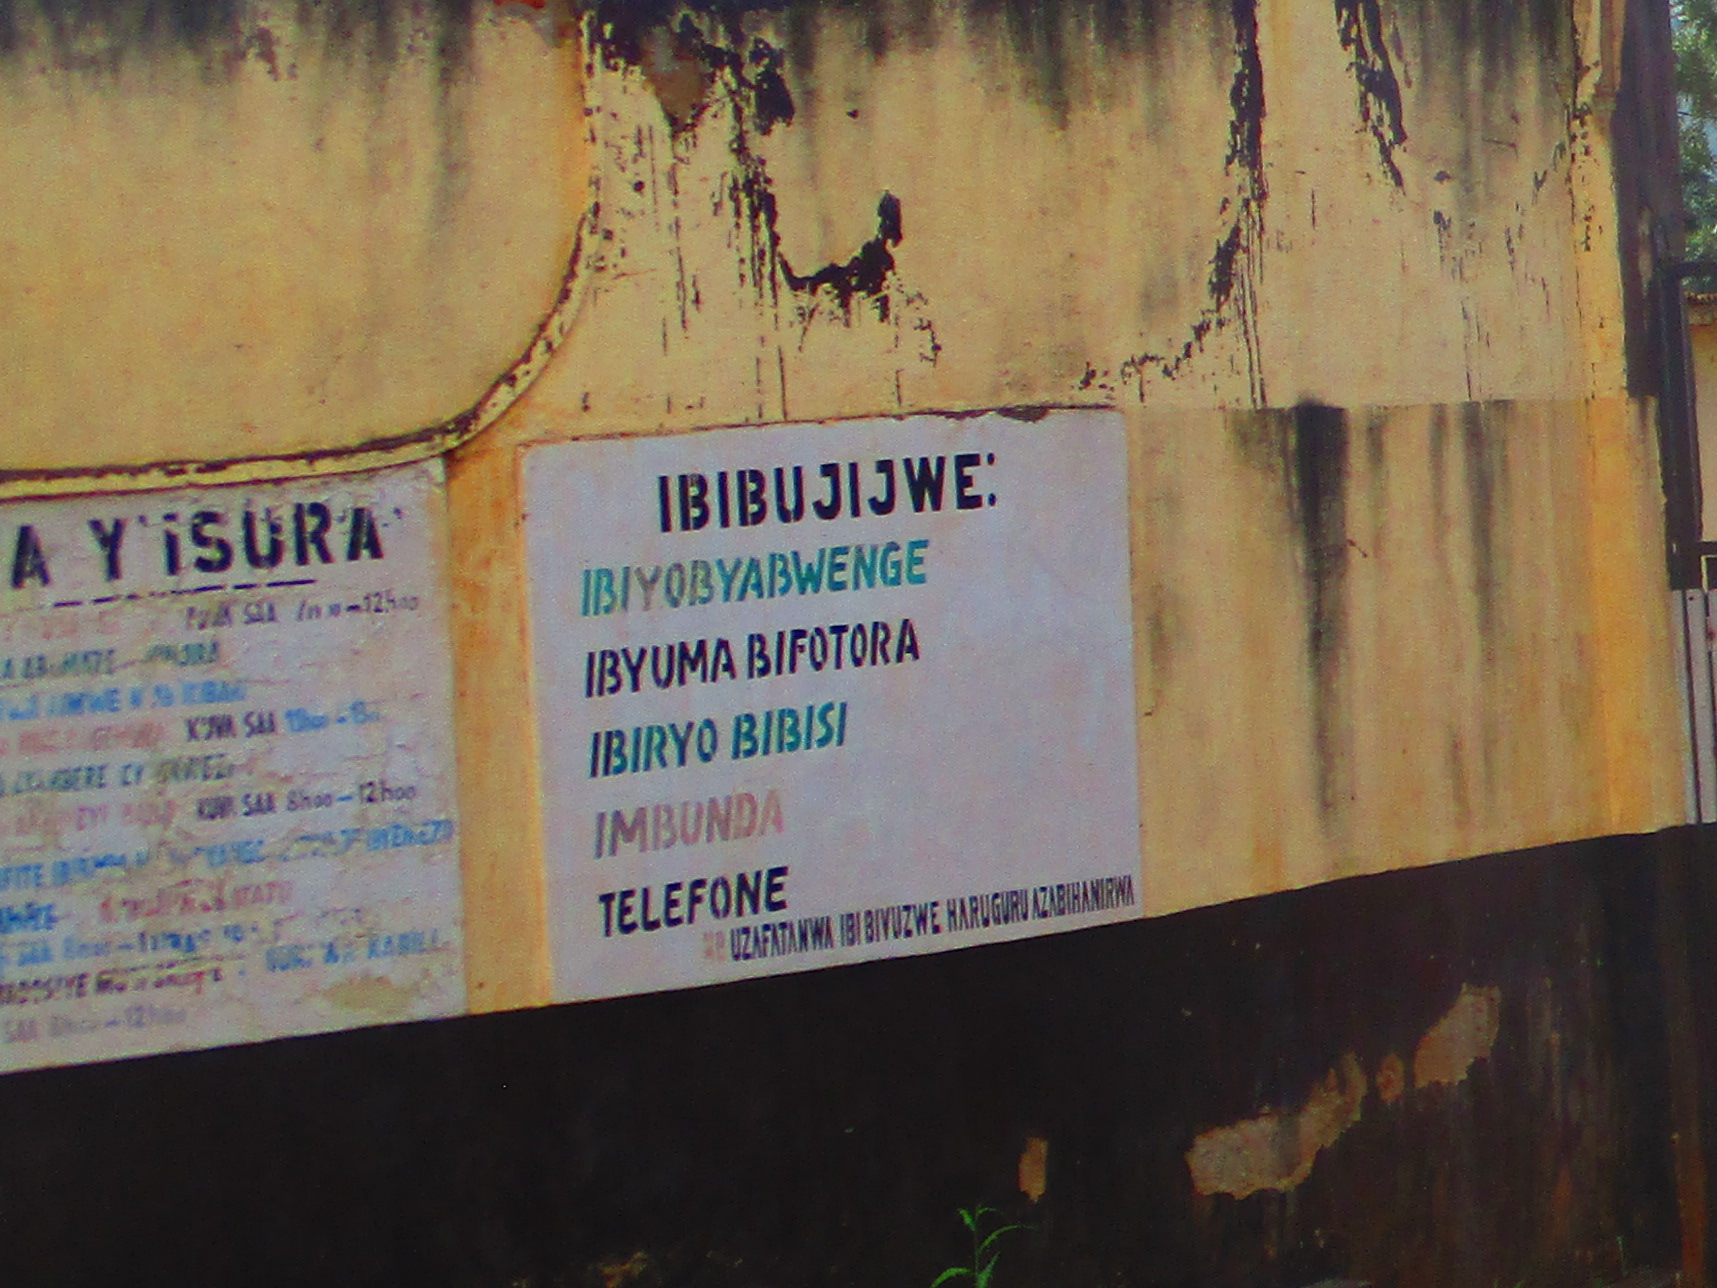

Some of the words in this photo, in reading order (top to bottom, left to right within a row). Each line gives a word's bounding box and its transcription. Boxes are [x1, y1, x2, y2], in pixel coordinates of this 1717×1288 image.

[657, 452, 998, 533] IBIBUJIJWE:
[581, 539, 930, 616] IBIYOBYABWENGE
[584, 636, 737, 698] IBYUMA
[746, 617, 920, 679] BIFOTORA
[589, 718, 718, 779] IBIRYO
[730, 701, 849, 761] BIBISI
[593, 787, 786, 860] IMBUNDA
[598, 865, 789, 938] TELEFONE
